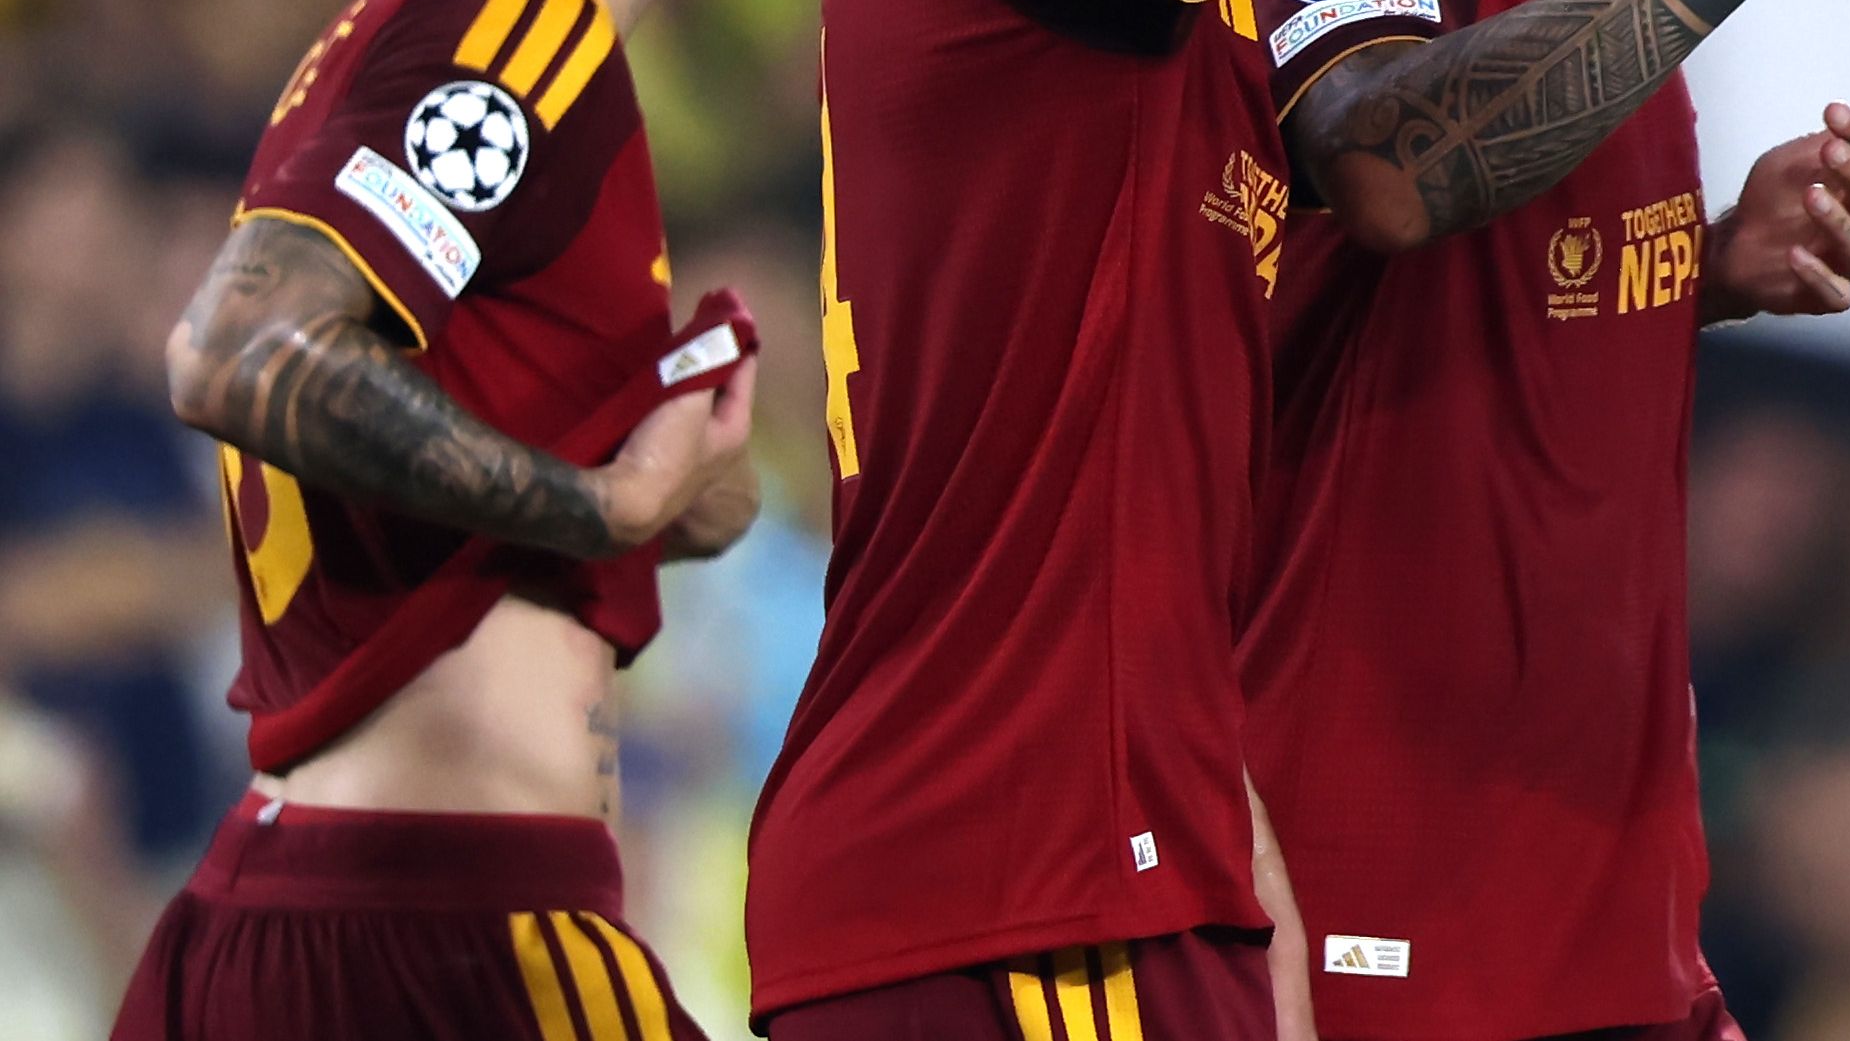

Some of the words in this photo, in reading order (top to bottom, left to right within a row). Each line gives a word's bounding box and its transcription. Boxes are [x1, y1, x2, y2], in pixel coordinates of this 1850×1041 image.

[1274, 15, 1303, 42] UEFA
[1203, 191, 1236, 212] World
[1621, 192, 1697, 242] TOGETHER
[352, 160, 470, 280] FOUNDATION
[1199, 203, 1250, 236] Programme
